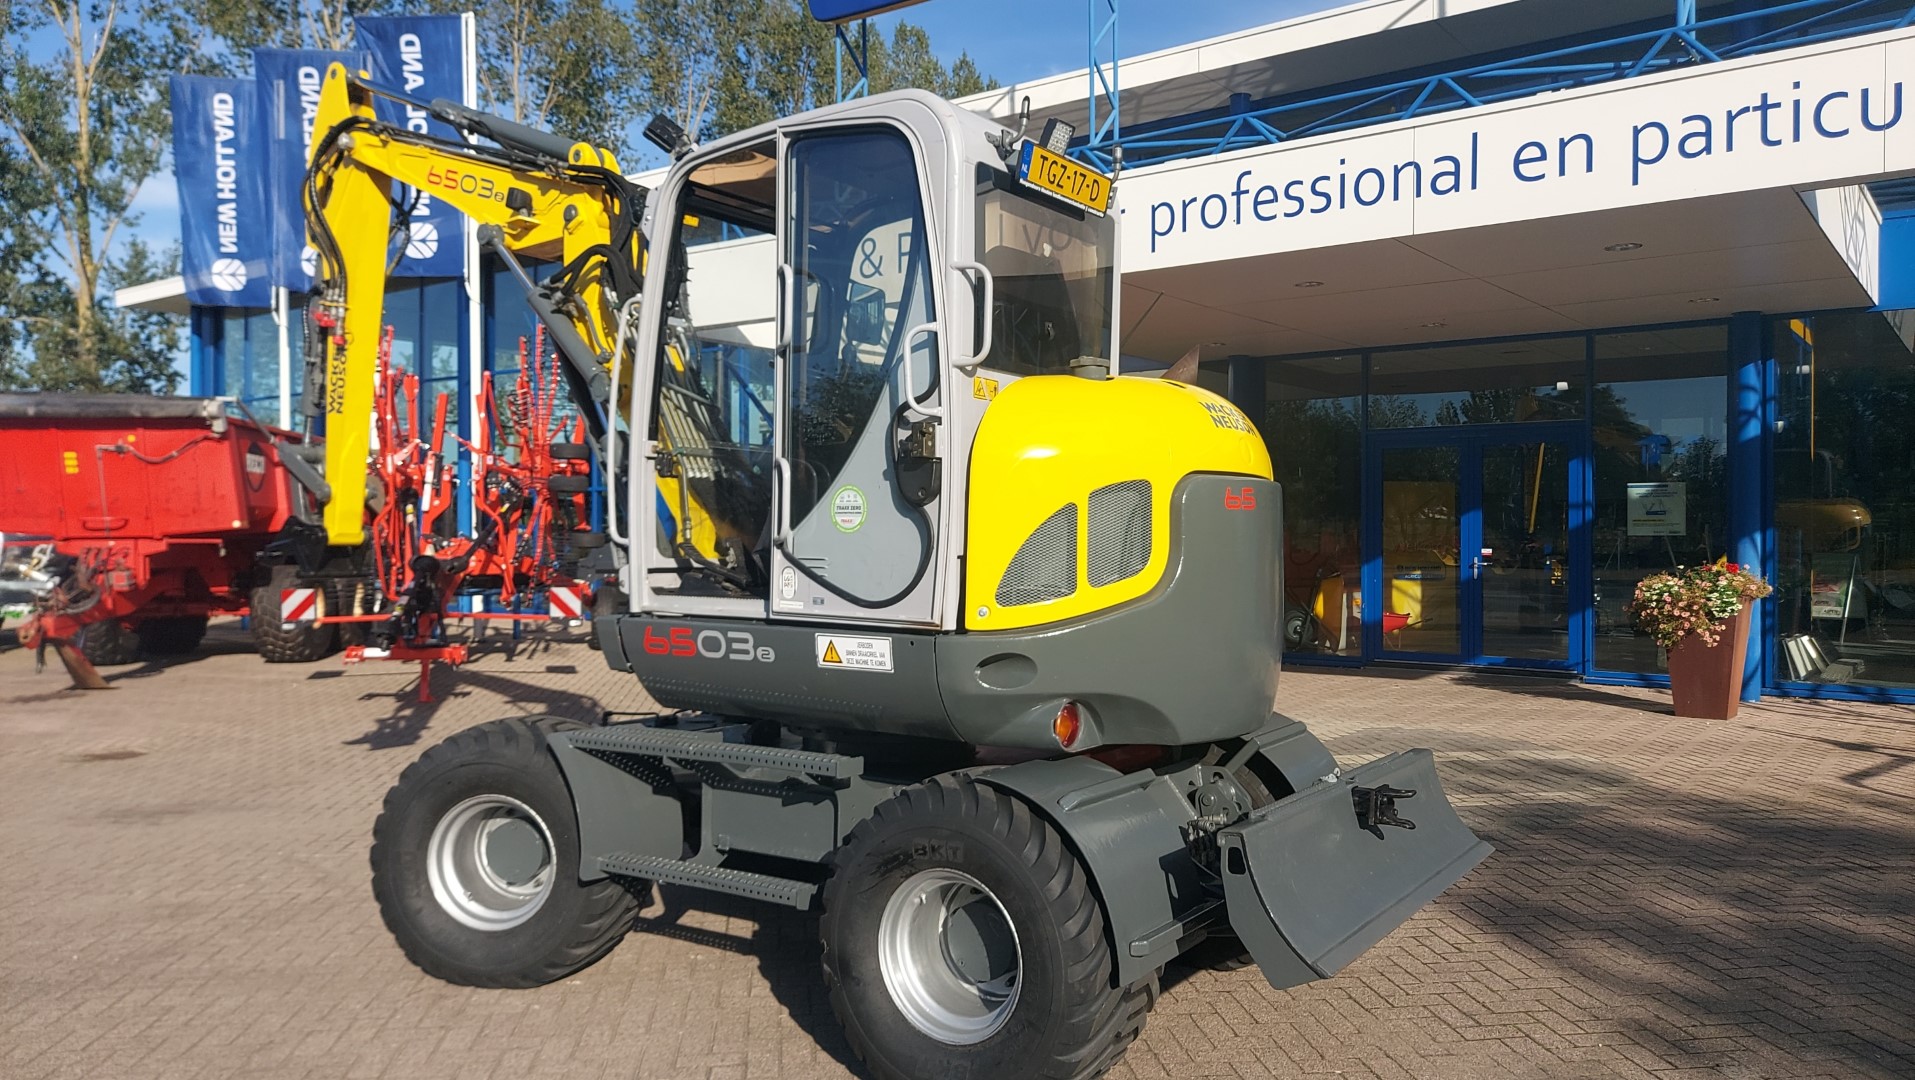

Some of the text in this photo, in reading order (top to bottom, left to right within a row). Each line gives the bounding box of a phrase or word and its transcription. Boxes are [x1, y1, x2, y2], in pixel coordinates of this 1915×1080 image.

[428, 165, 494, 199] 6503
[1039, 154, 1100, 202] TGZ-17-D
[1151, 81, 1903, 253] professional en particu
[1225, 486, 1257, 511] 65
[643, 625, 755, 661] 6503
